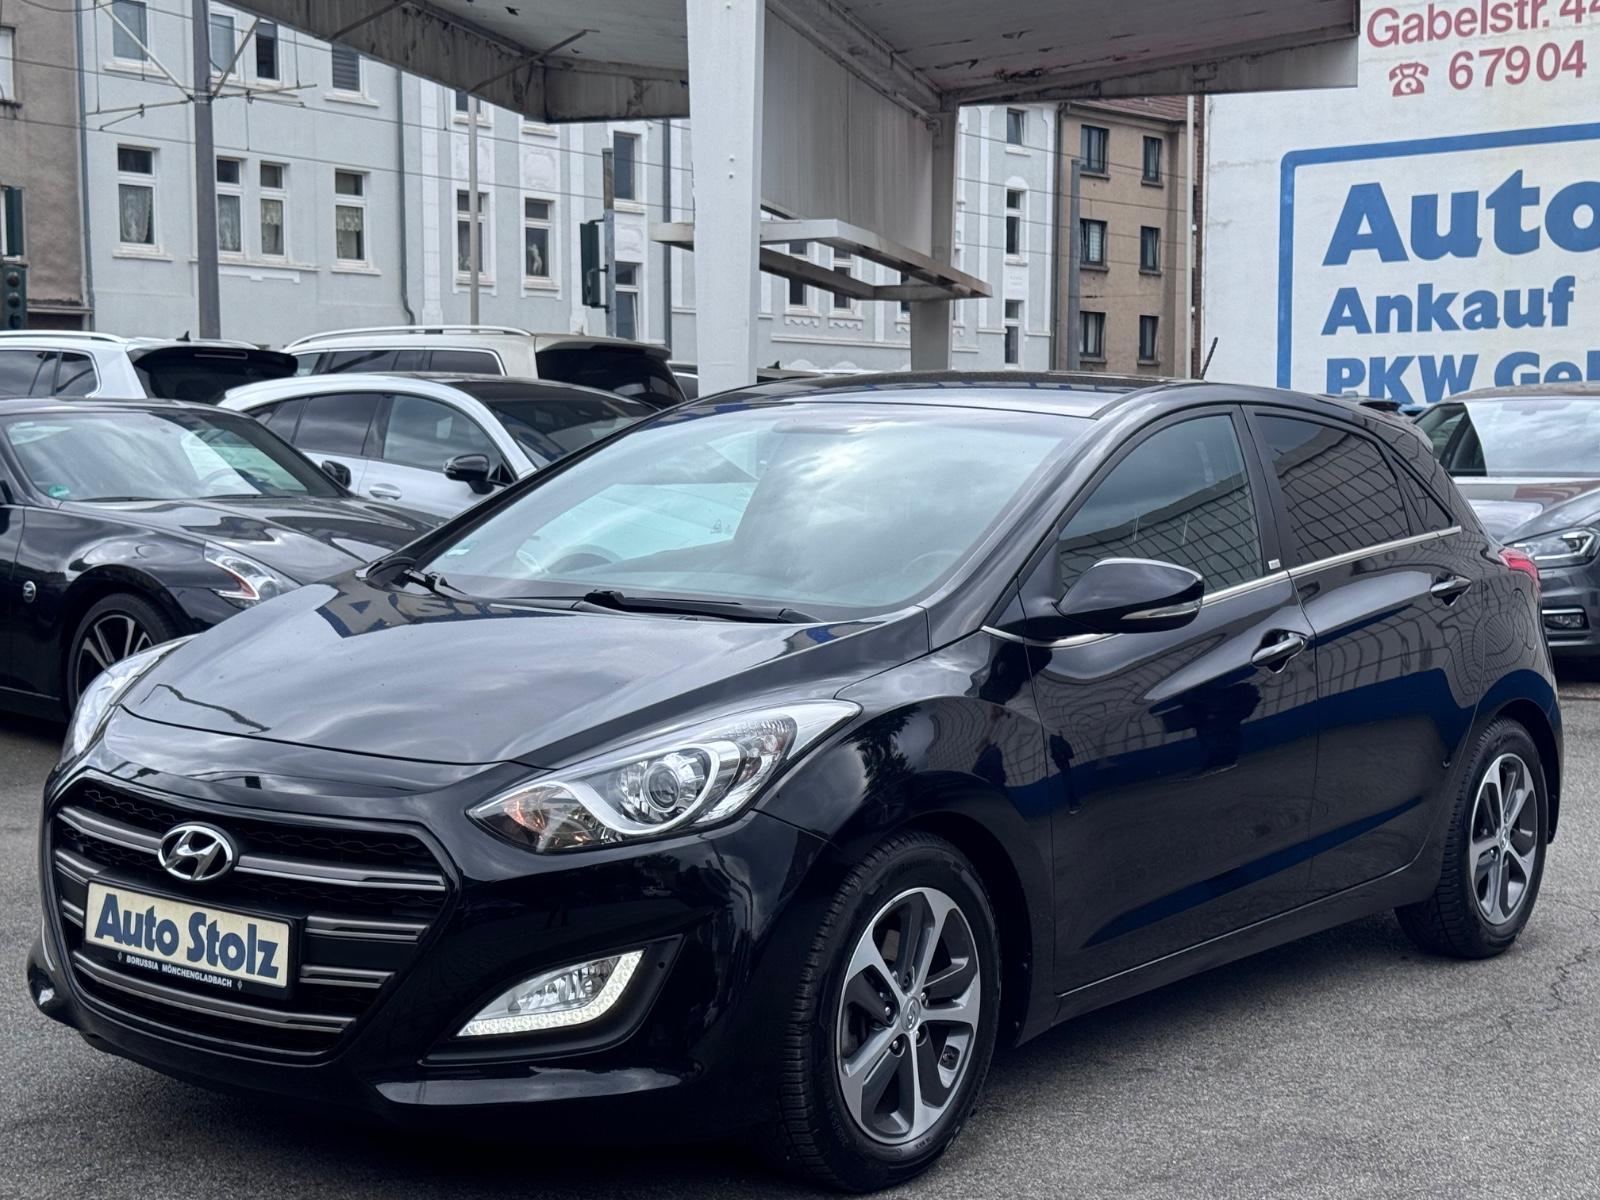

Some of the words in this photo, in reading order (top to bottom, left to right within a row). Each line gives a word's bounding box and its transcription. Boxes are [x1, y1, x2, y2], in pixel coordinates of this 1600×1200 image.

[1367, 0, 1549, 47] Gabelstr.
[1559, 0, 1600, 24] 4
[1322, 169, 1600, 266] Auto
[1321, 275, 1575, 335] Ankauf
[1326, 354, 1479, 404] PKW
[95, 893, 179, 956] Auto
[187, 911, 280, 979] Stolz
[126, 955, 159, 970] BORUSSIA
[161, 964, 232, 987] MÖNCHENGLADBACH
